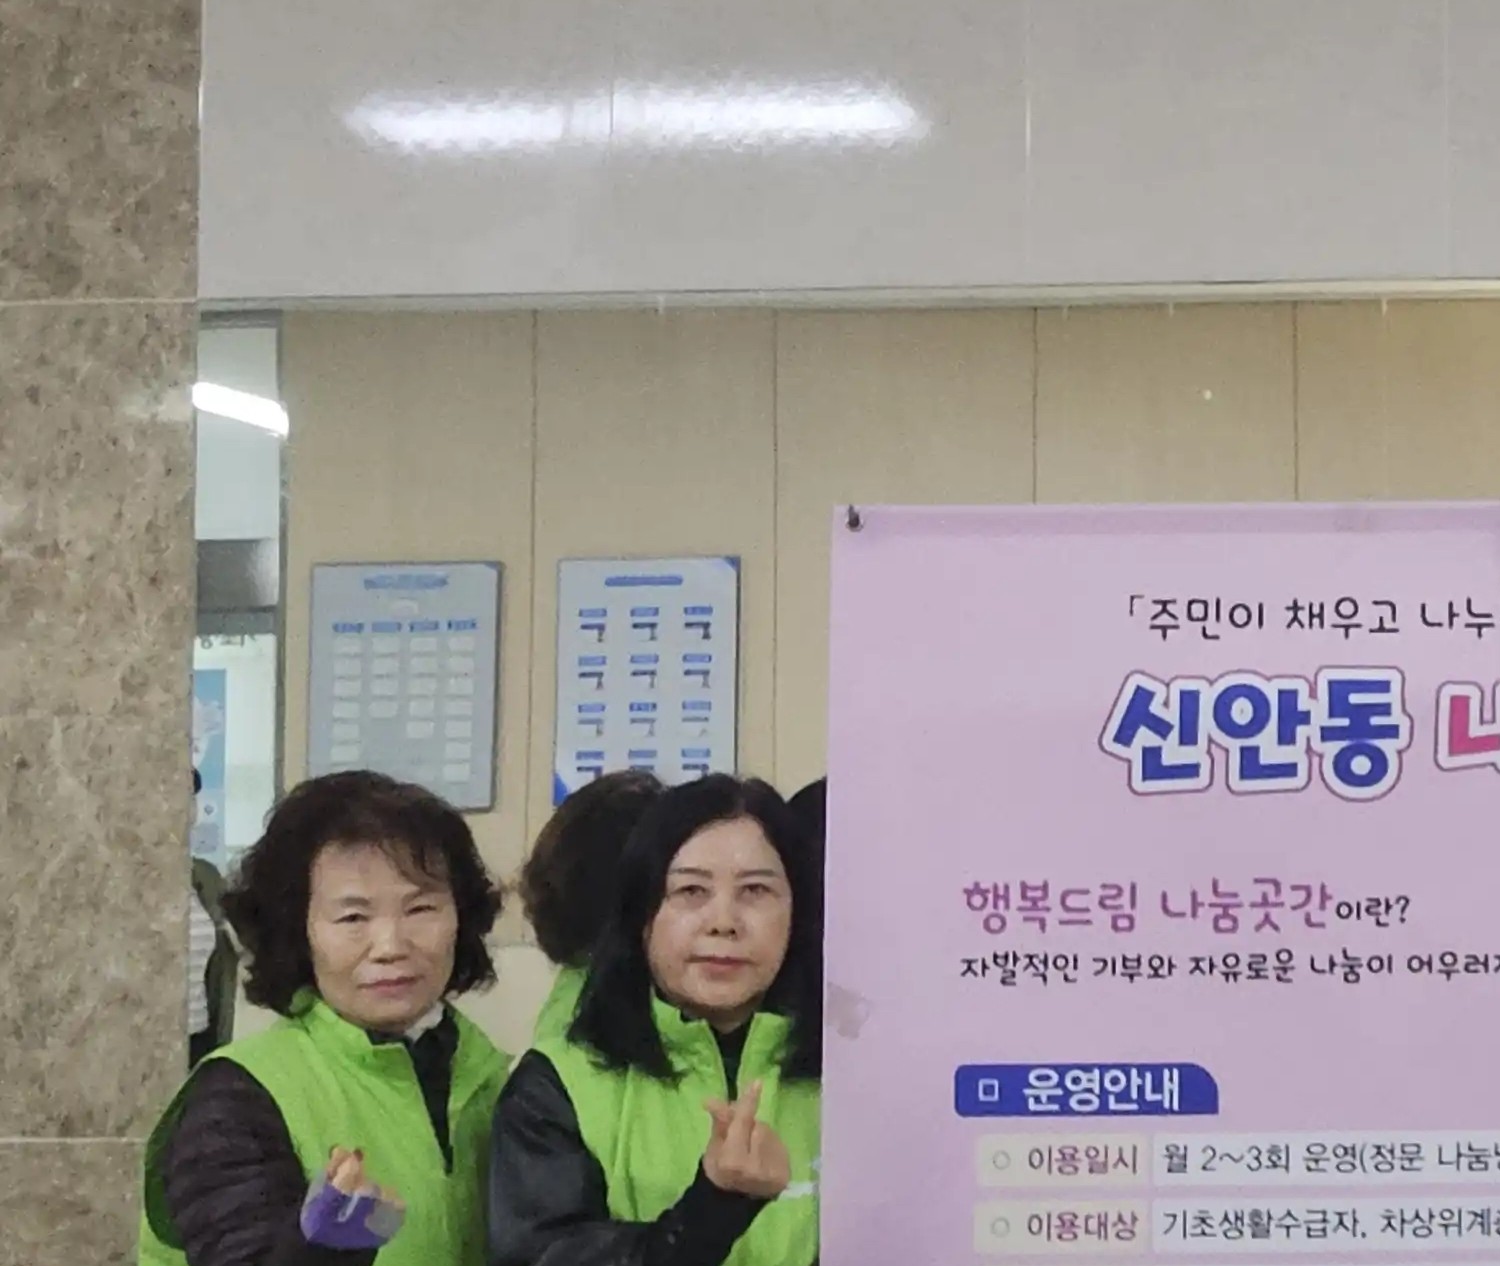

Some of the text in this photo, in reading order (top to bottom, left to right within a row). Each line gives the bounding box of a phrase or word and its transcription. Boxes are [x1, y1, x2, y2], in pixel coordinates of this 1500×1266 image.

[1284, 595, 1400, 639] 채우고
[1102, 669, 1409, 799] 신안동
[962, 876, 1412, 935] 행복드림 나눔곳간이란?
[960, 949, 1081, 987] 자발적인
[1091, 952, 1178, 982] 기부와
[1188, 947, 1296, 985] 자유로운
[1308, 946, 1394, 984] 나눔이
[1022, 1066, 1181, 1113] 운영안내
[1026, 1144, 1140, 1176] 이용일시
[1162, 1142, 1190, 1175] 월
[1302, 1141, 1426, 1177] 운영(정문
[1025, 1209, 1140, 1244] 이용대상
